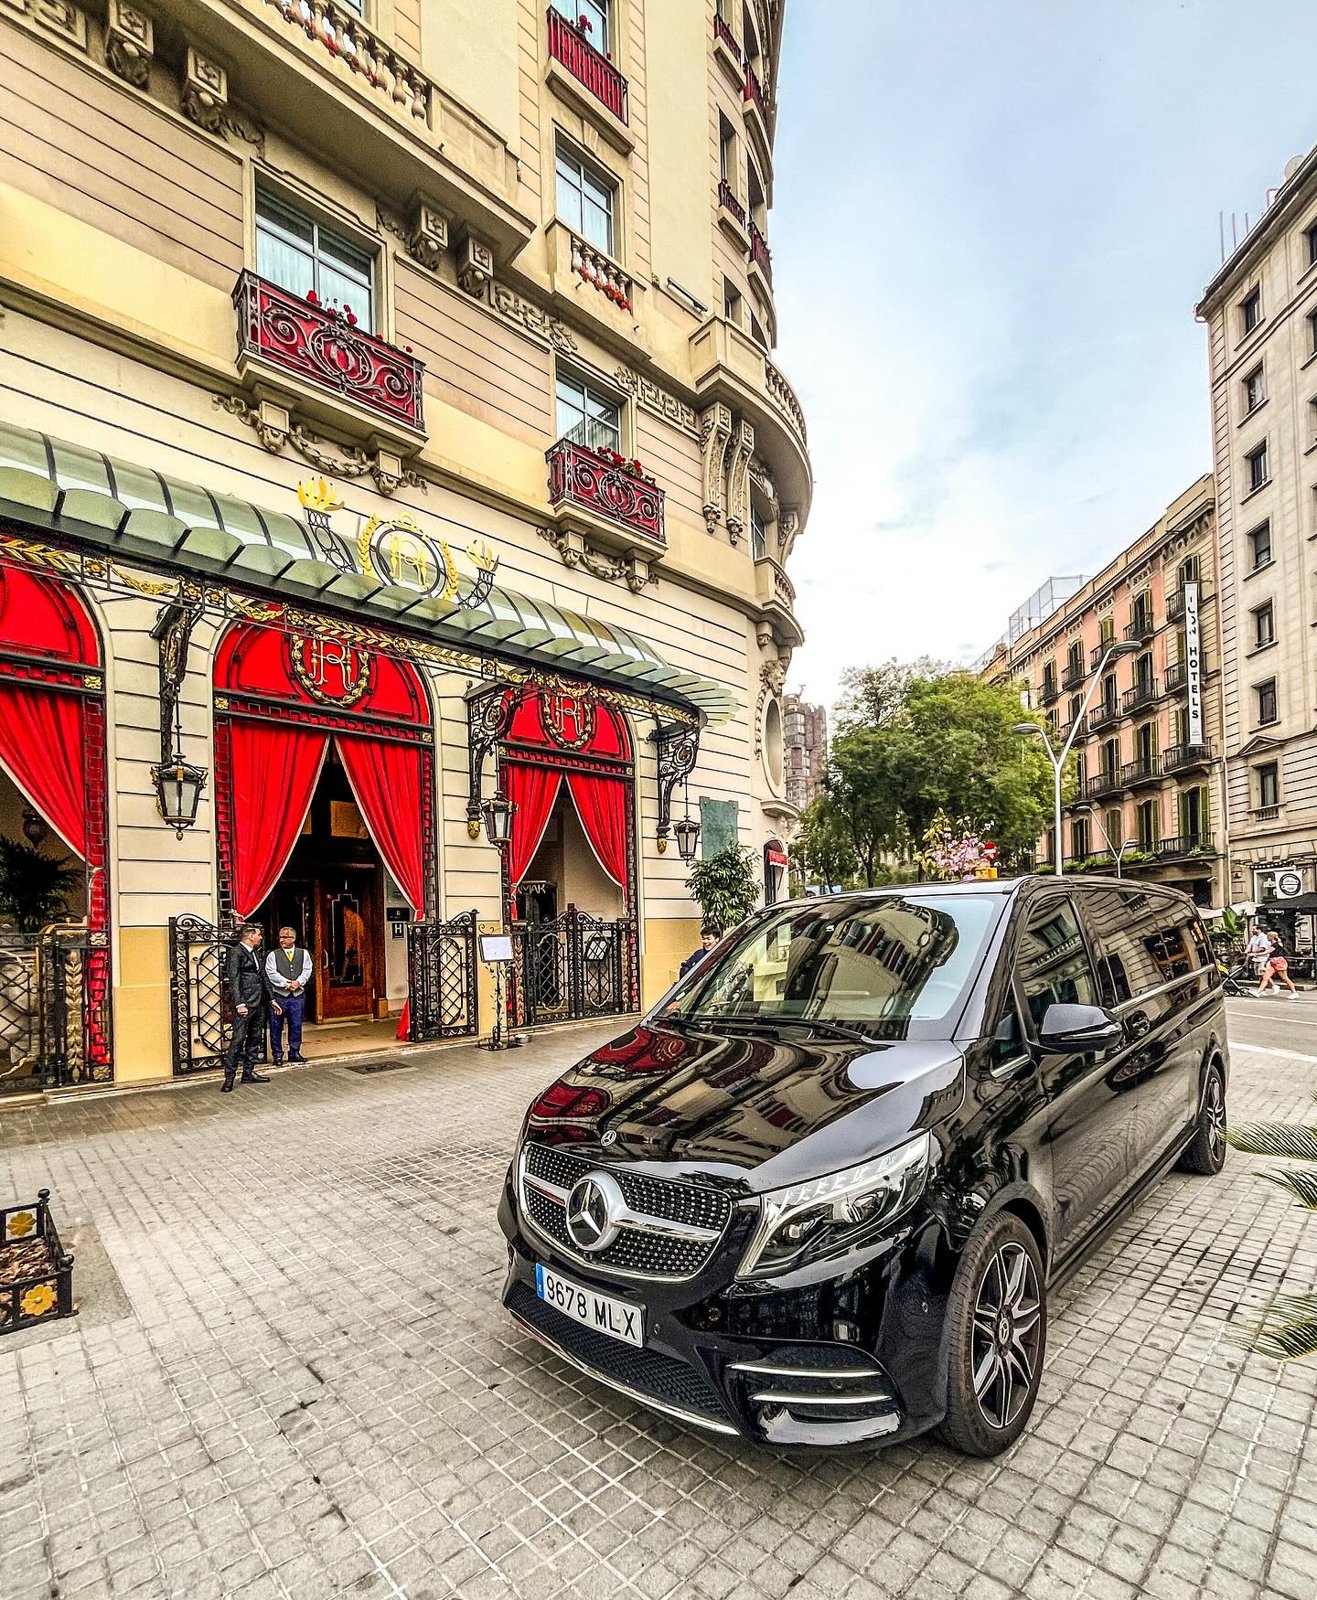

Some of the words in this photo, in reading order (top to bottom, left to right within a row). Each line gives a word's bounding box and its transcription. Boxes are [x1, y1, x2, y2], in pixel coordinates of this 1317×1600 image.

[1189, 647, 1199, 719] HOTELS
[394, 924, 402, 934] H
[546, 1275, 588, 1319] 9678
[594, 1298, 637, 1340] MLX
